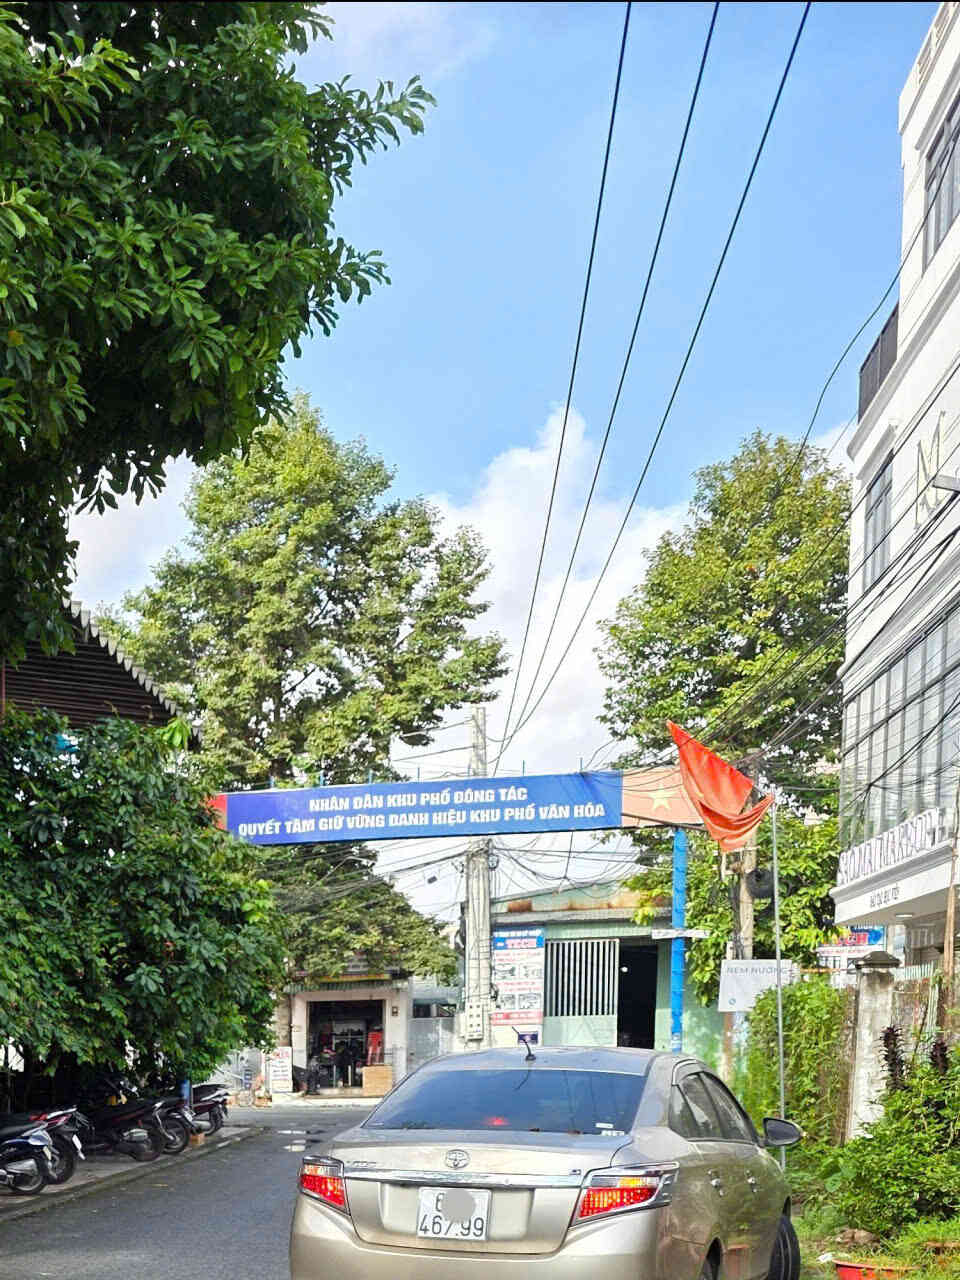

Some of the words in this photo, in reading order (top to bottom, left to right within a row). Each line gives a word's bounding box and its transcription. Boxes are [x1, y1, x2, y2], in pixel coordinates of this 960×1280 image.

[309, 797, 349, 812] NHÂN
[387, 792, 416, 808] KHU
[420, 786, 450, 806] PHỐ
[499, 785, 528, 801] TÁC
[239, 818, 281, 837] QUYẾT
[285, 819, 315, 834] TÂM
[318, 815, 345, 832] GIỮ
[347, 812, 385, 830] VỮNG
[389, 811, 429, 828] DANH
[432, 809, 466, 827] HIỆU
[470, 808, 500, 823] KHU
[504, 803, 535, 821] PHỐ
[539, 803, 570, 819] VĂN
[574, 801, 606, 817] HÓA
